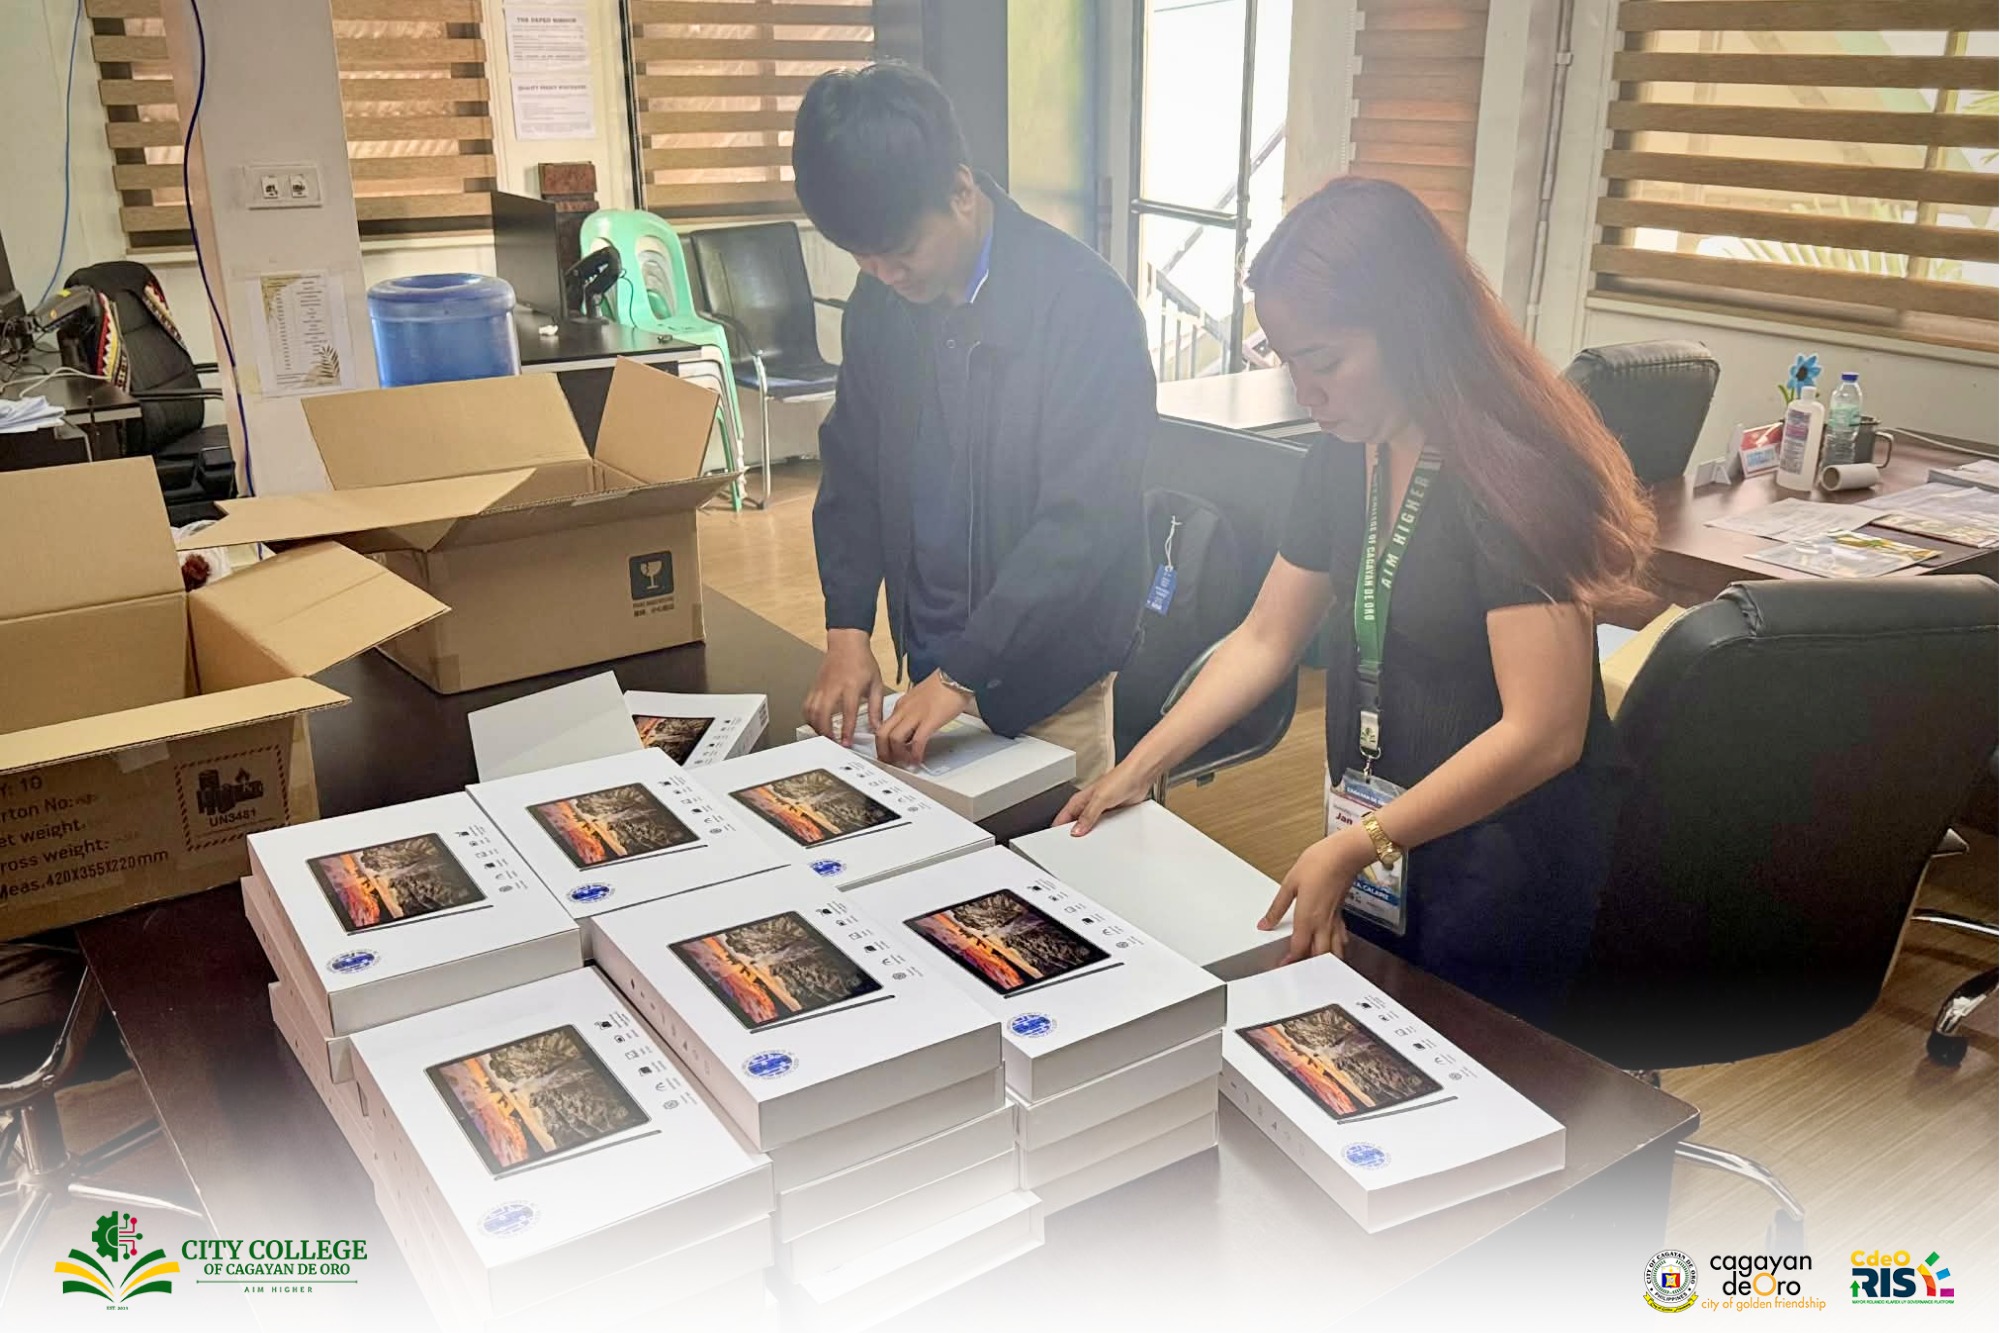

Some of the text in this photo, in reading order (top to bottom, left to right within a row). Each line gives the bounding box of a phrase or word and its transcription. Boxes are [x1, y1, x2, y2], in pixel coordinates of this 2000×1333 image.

[1381, 476, 1430, 589] AIM HIGHER
[1364, 547, 1376, 586] CAGAYAN
[1364, 588, 1374, 600] DE
[1364, 602, 1375, 620] ORO
[20, 775, 43, 792] 10
[0, 804, 40, 824] rton
[209, 808, 256, 828] UN3481
[1335, 812, 1353, 826] Jan
[43, 838, 110, 864] weight:
